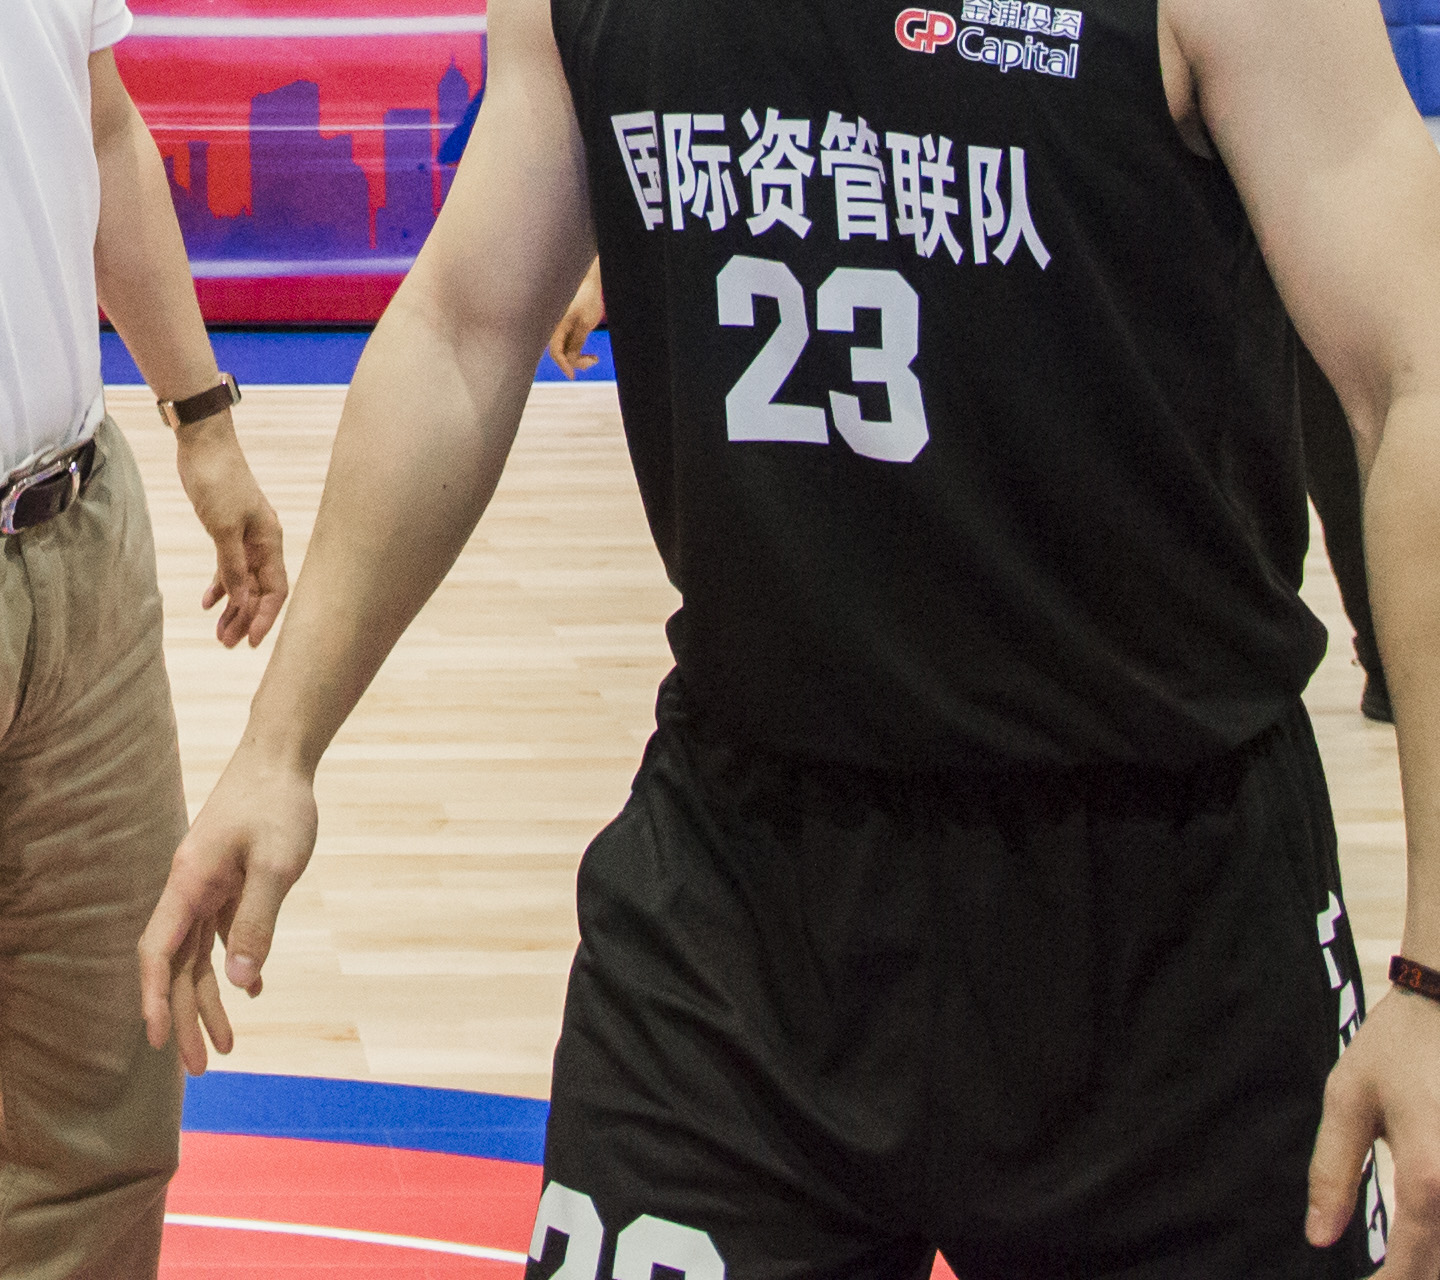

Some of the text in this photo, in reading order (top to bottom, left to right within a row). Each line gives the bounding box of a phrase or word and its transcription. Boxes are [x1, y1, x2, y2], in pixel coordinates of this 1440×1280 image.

[894, 8, 1080, 79] GP Capital
[716, 255, 929, 462] 23
